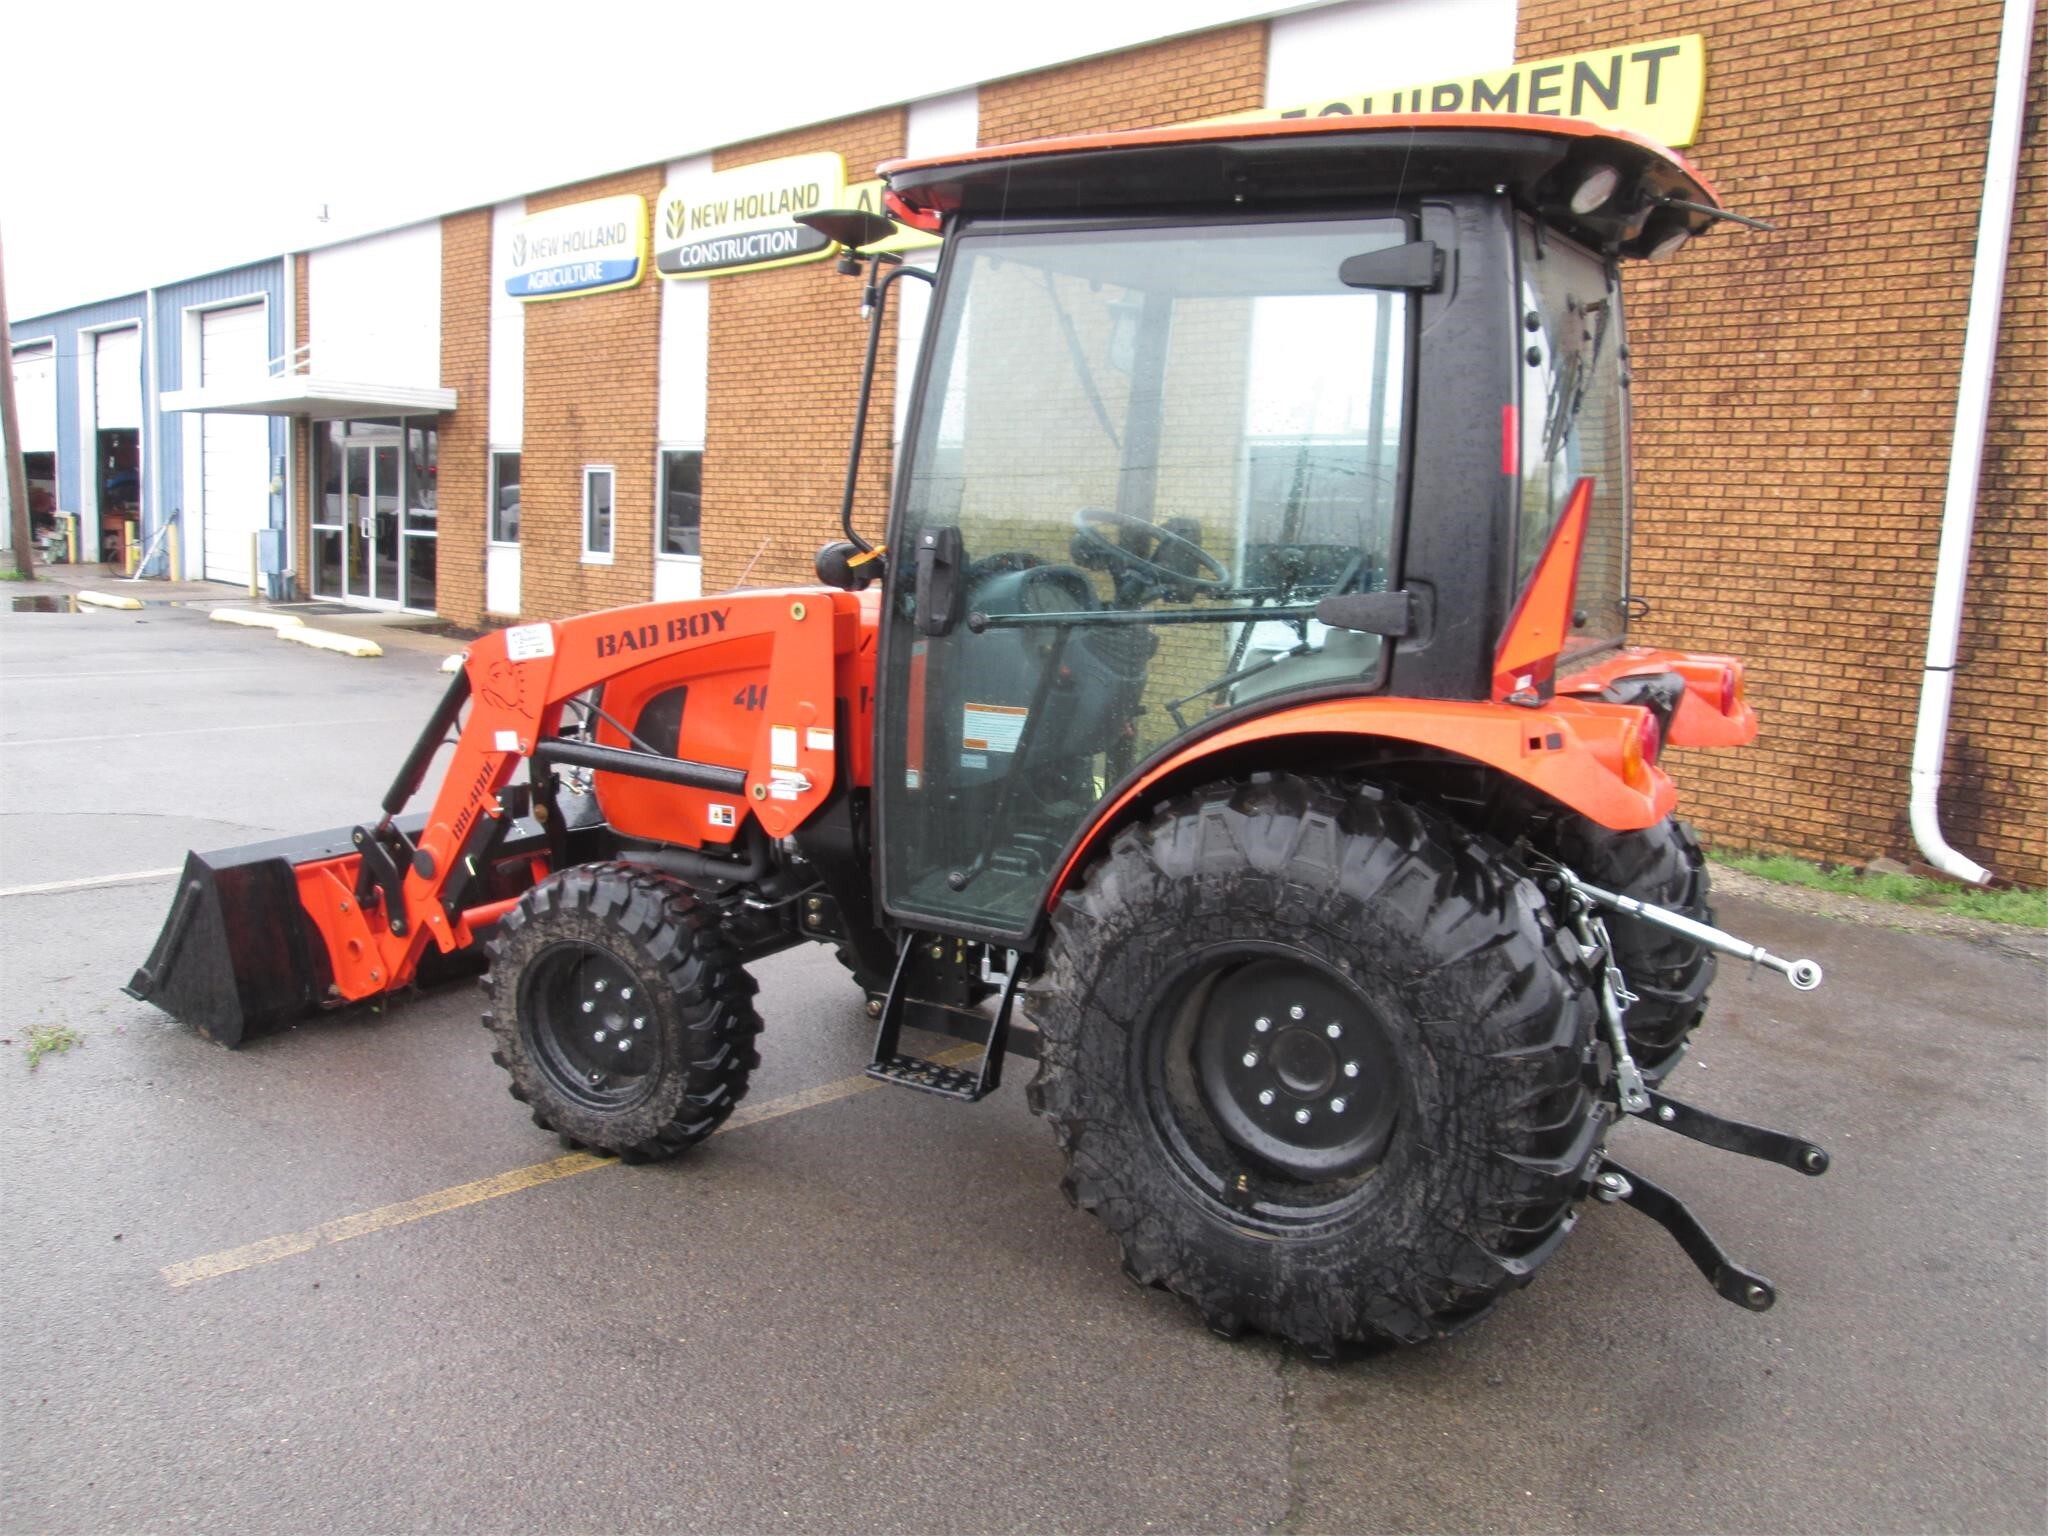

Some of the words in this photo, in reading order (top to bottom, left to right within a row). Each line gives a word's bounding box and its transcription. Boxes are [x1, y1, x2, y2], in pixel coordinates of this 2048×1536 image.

[691, 201, 728, 230] NEW
[734, 183, 819, 221] HOLLAND
[531, 236, 558, 260] NEW
[562, 222, 626, 253] HOLLAND
[680, 229, 797, 266] CONSTRUCTION
[528, 262, 603, 290] AGRICULTURE
[597, 624, 659, 658] BAD
[667, 607, 731, 642] BOY
